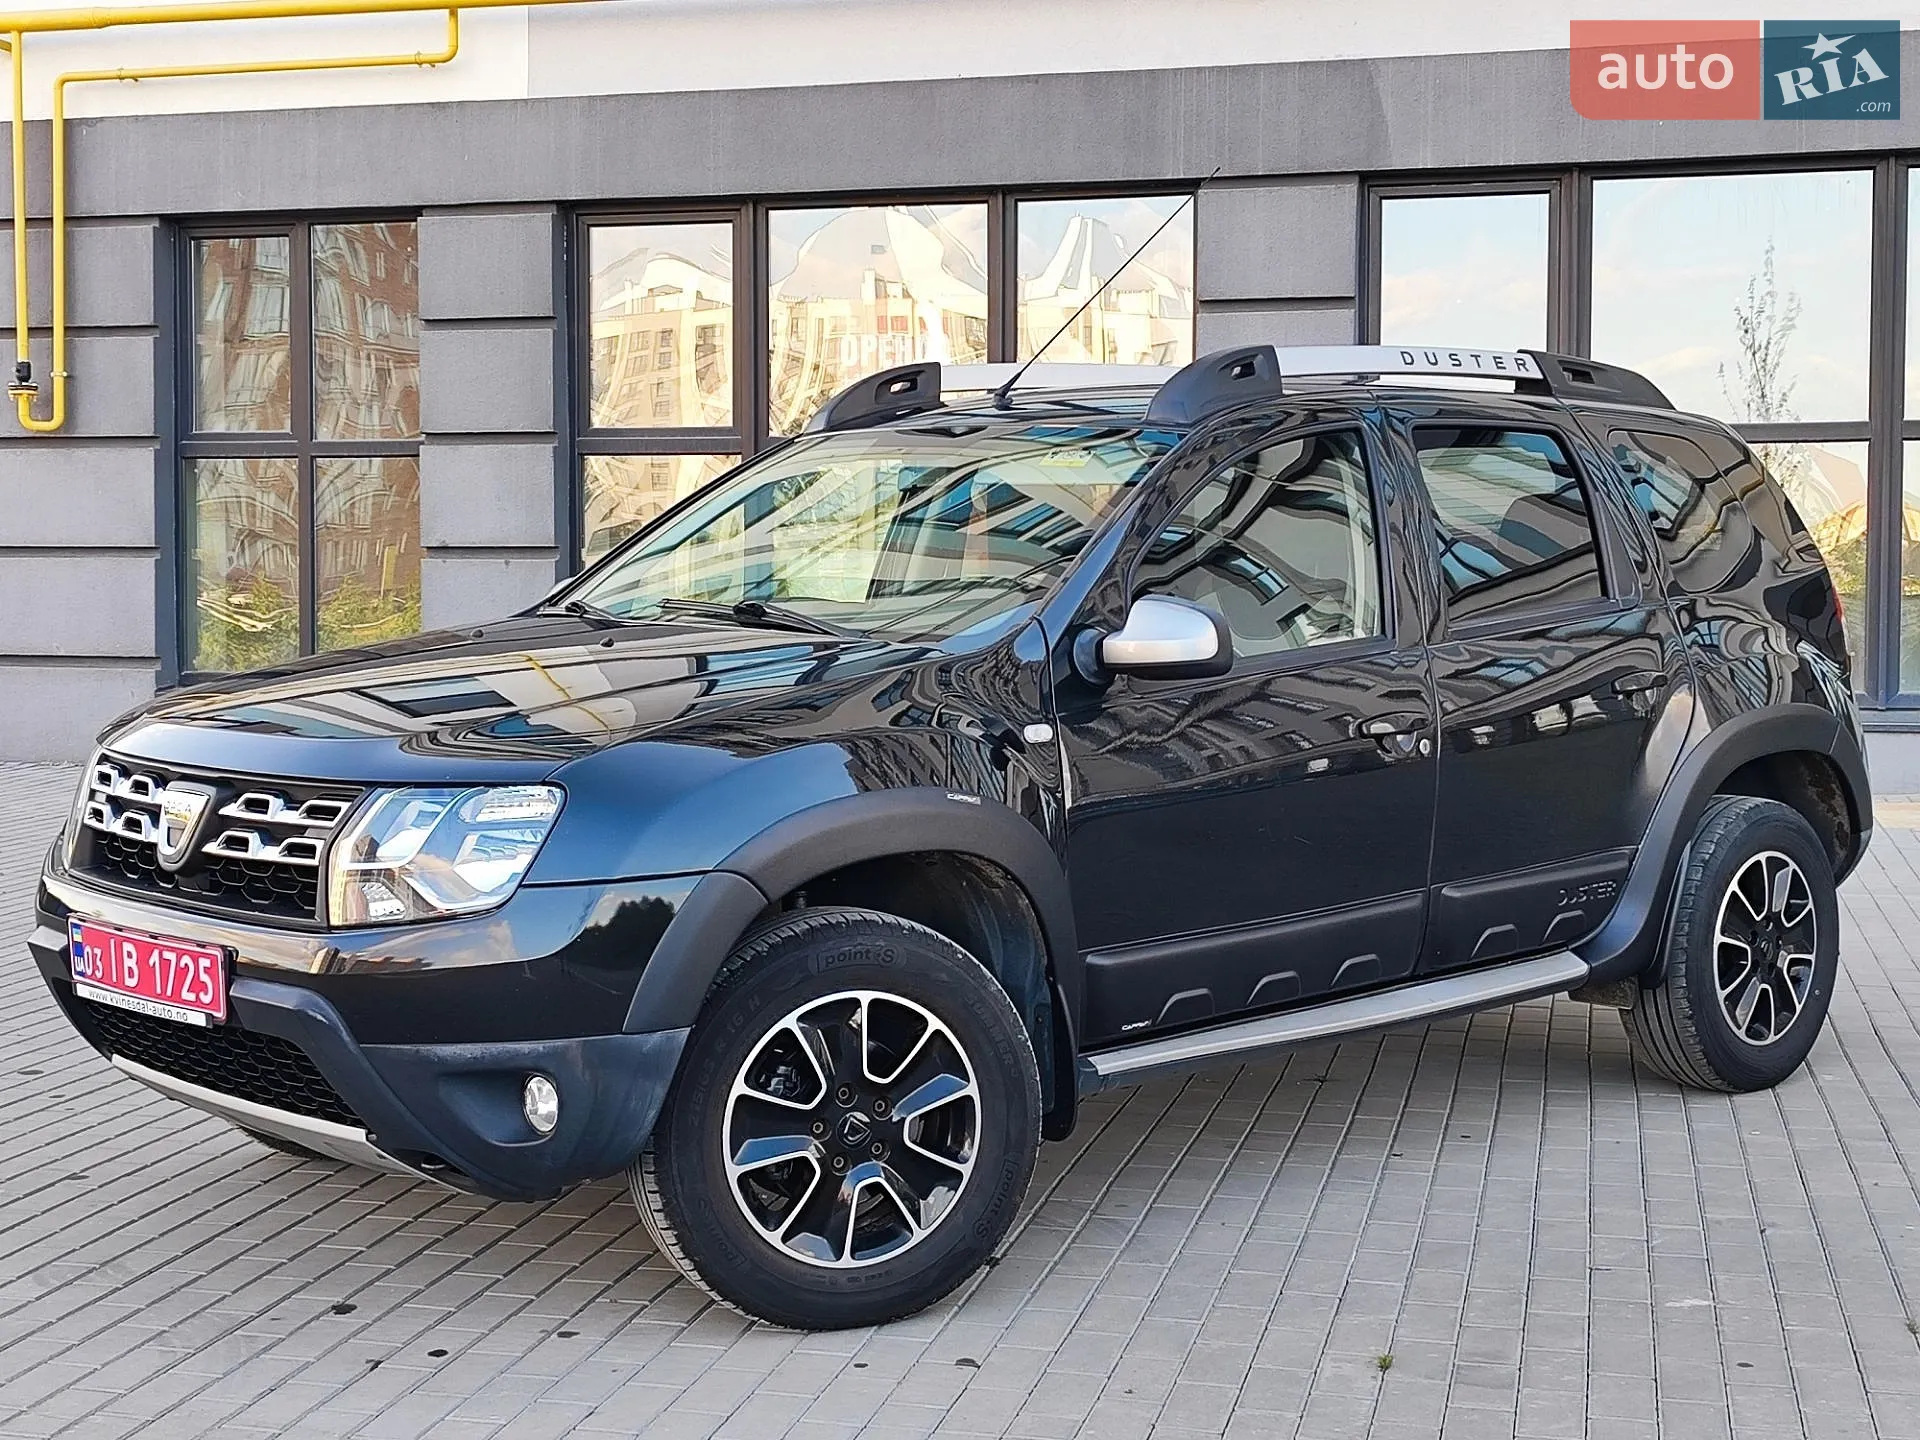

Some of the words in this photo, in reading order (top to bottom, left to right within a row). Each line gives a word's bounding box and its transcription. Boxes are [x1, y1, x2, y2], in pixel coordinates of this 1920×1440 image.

[1400, 351, 1529, 372] DUSTER
[75, 957, 85, 973] UA
[825, 948, 872, 967] point
[84, 945, 102, 979] 03
[149, 949, 213, 1005] 1725
[88, 990, 188, 1022] www.kvinesdal-auto.no
